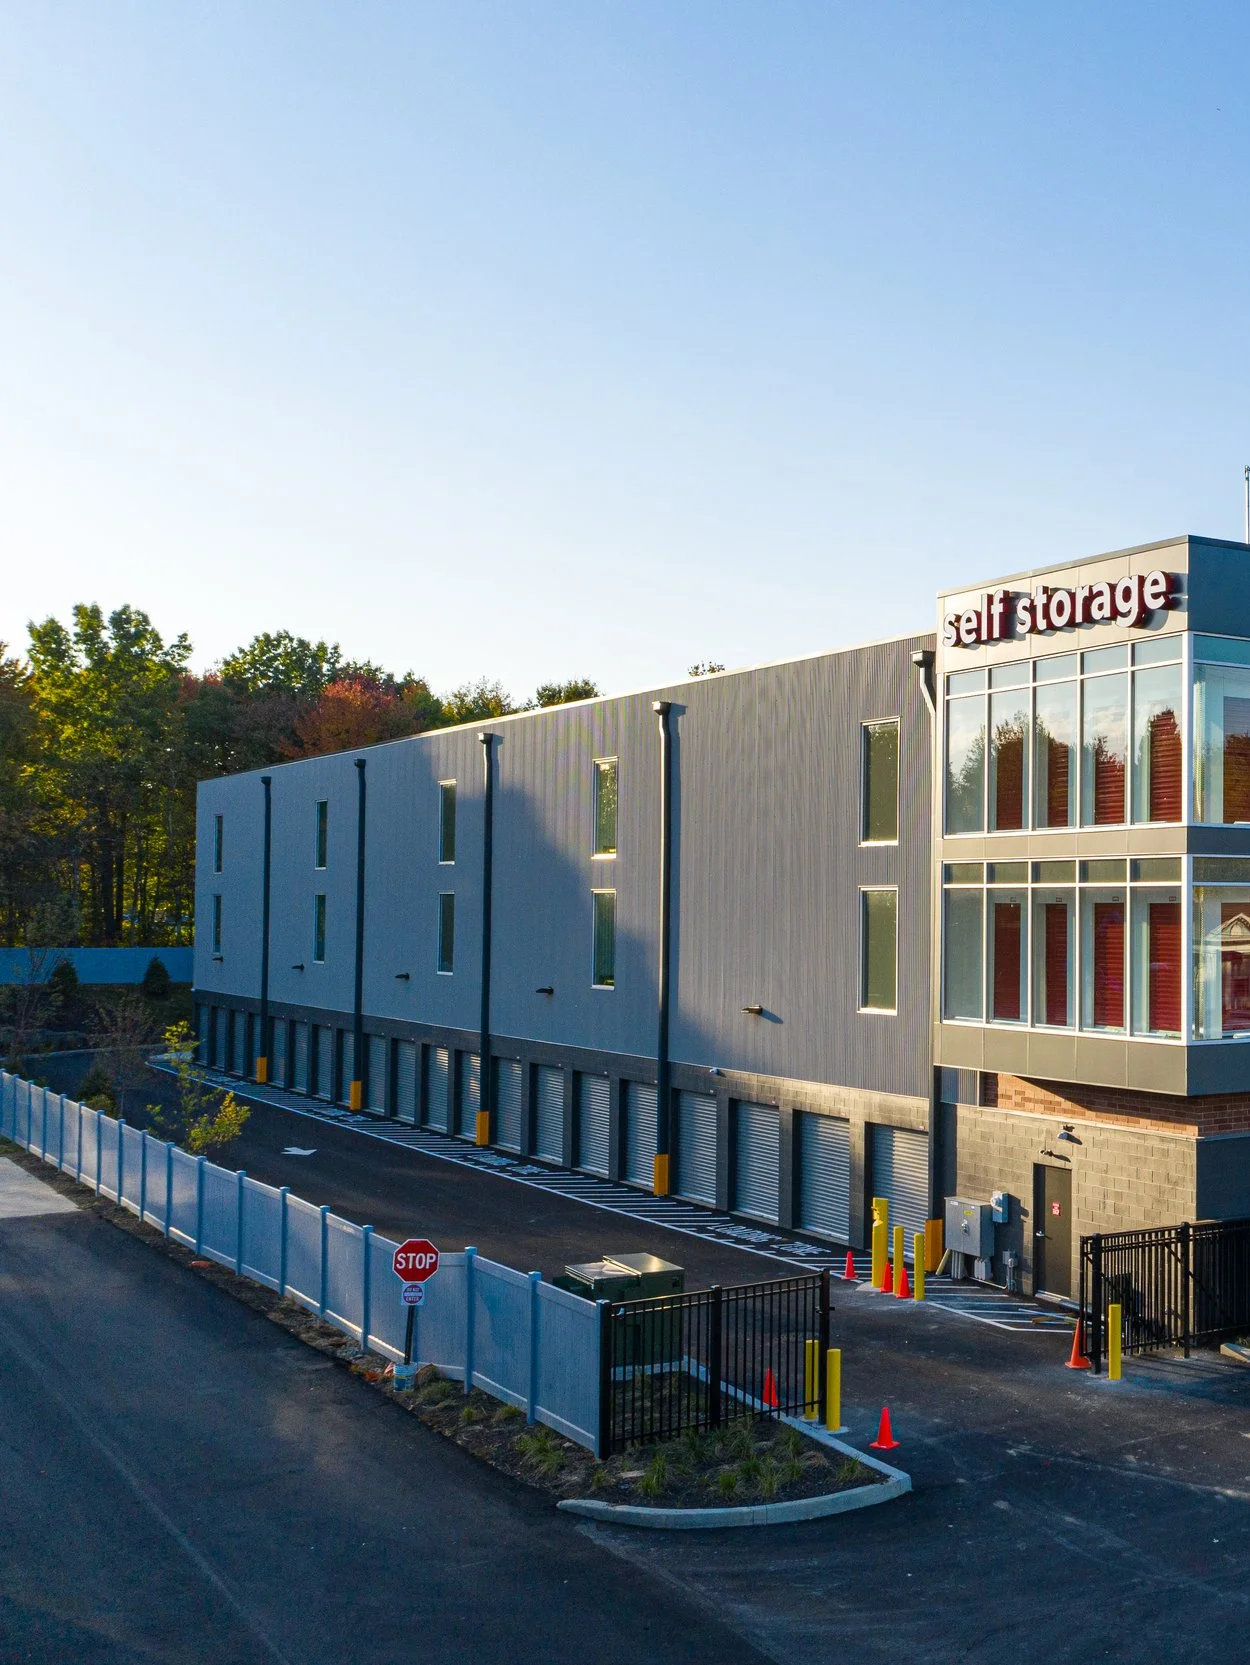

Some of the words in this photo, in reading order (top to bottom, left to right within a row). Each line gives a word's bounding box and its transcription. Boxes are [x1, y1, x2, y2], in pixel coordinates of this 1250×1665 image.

[943, 589, 1008, 647] self
[1016, 570, 1168, 633] storage
[396, 1253, 436, 1269] STOP
